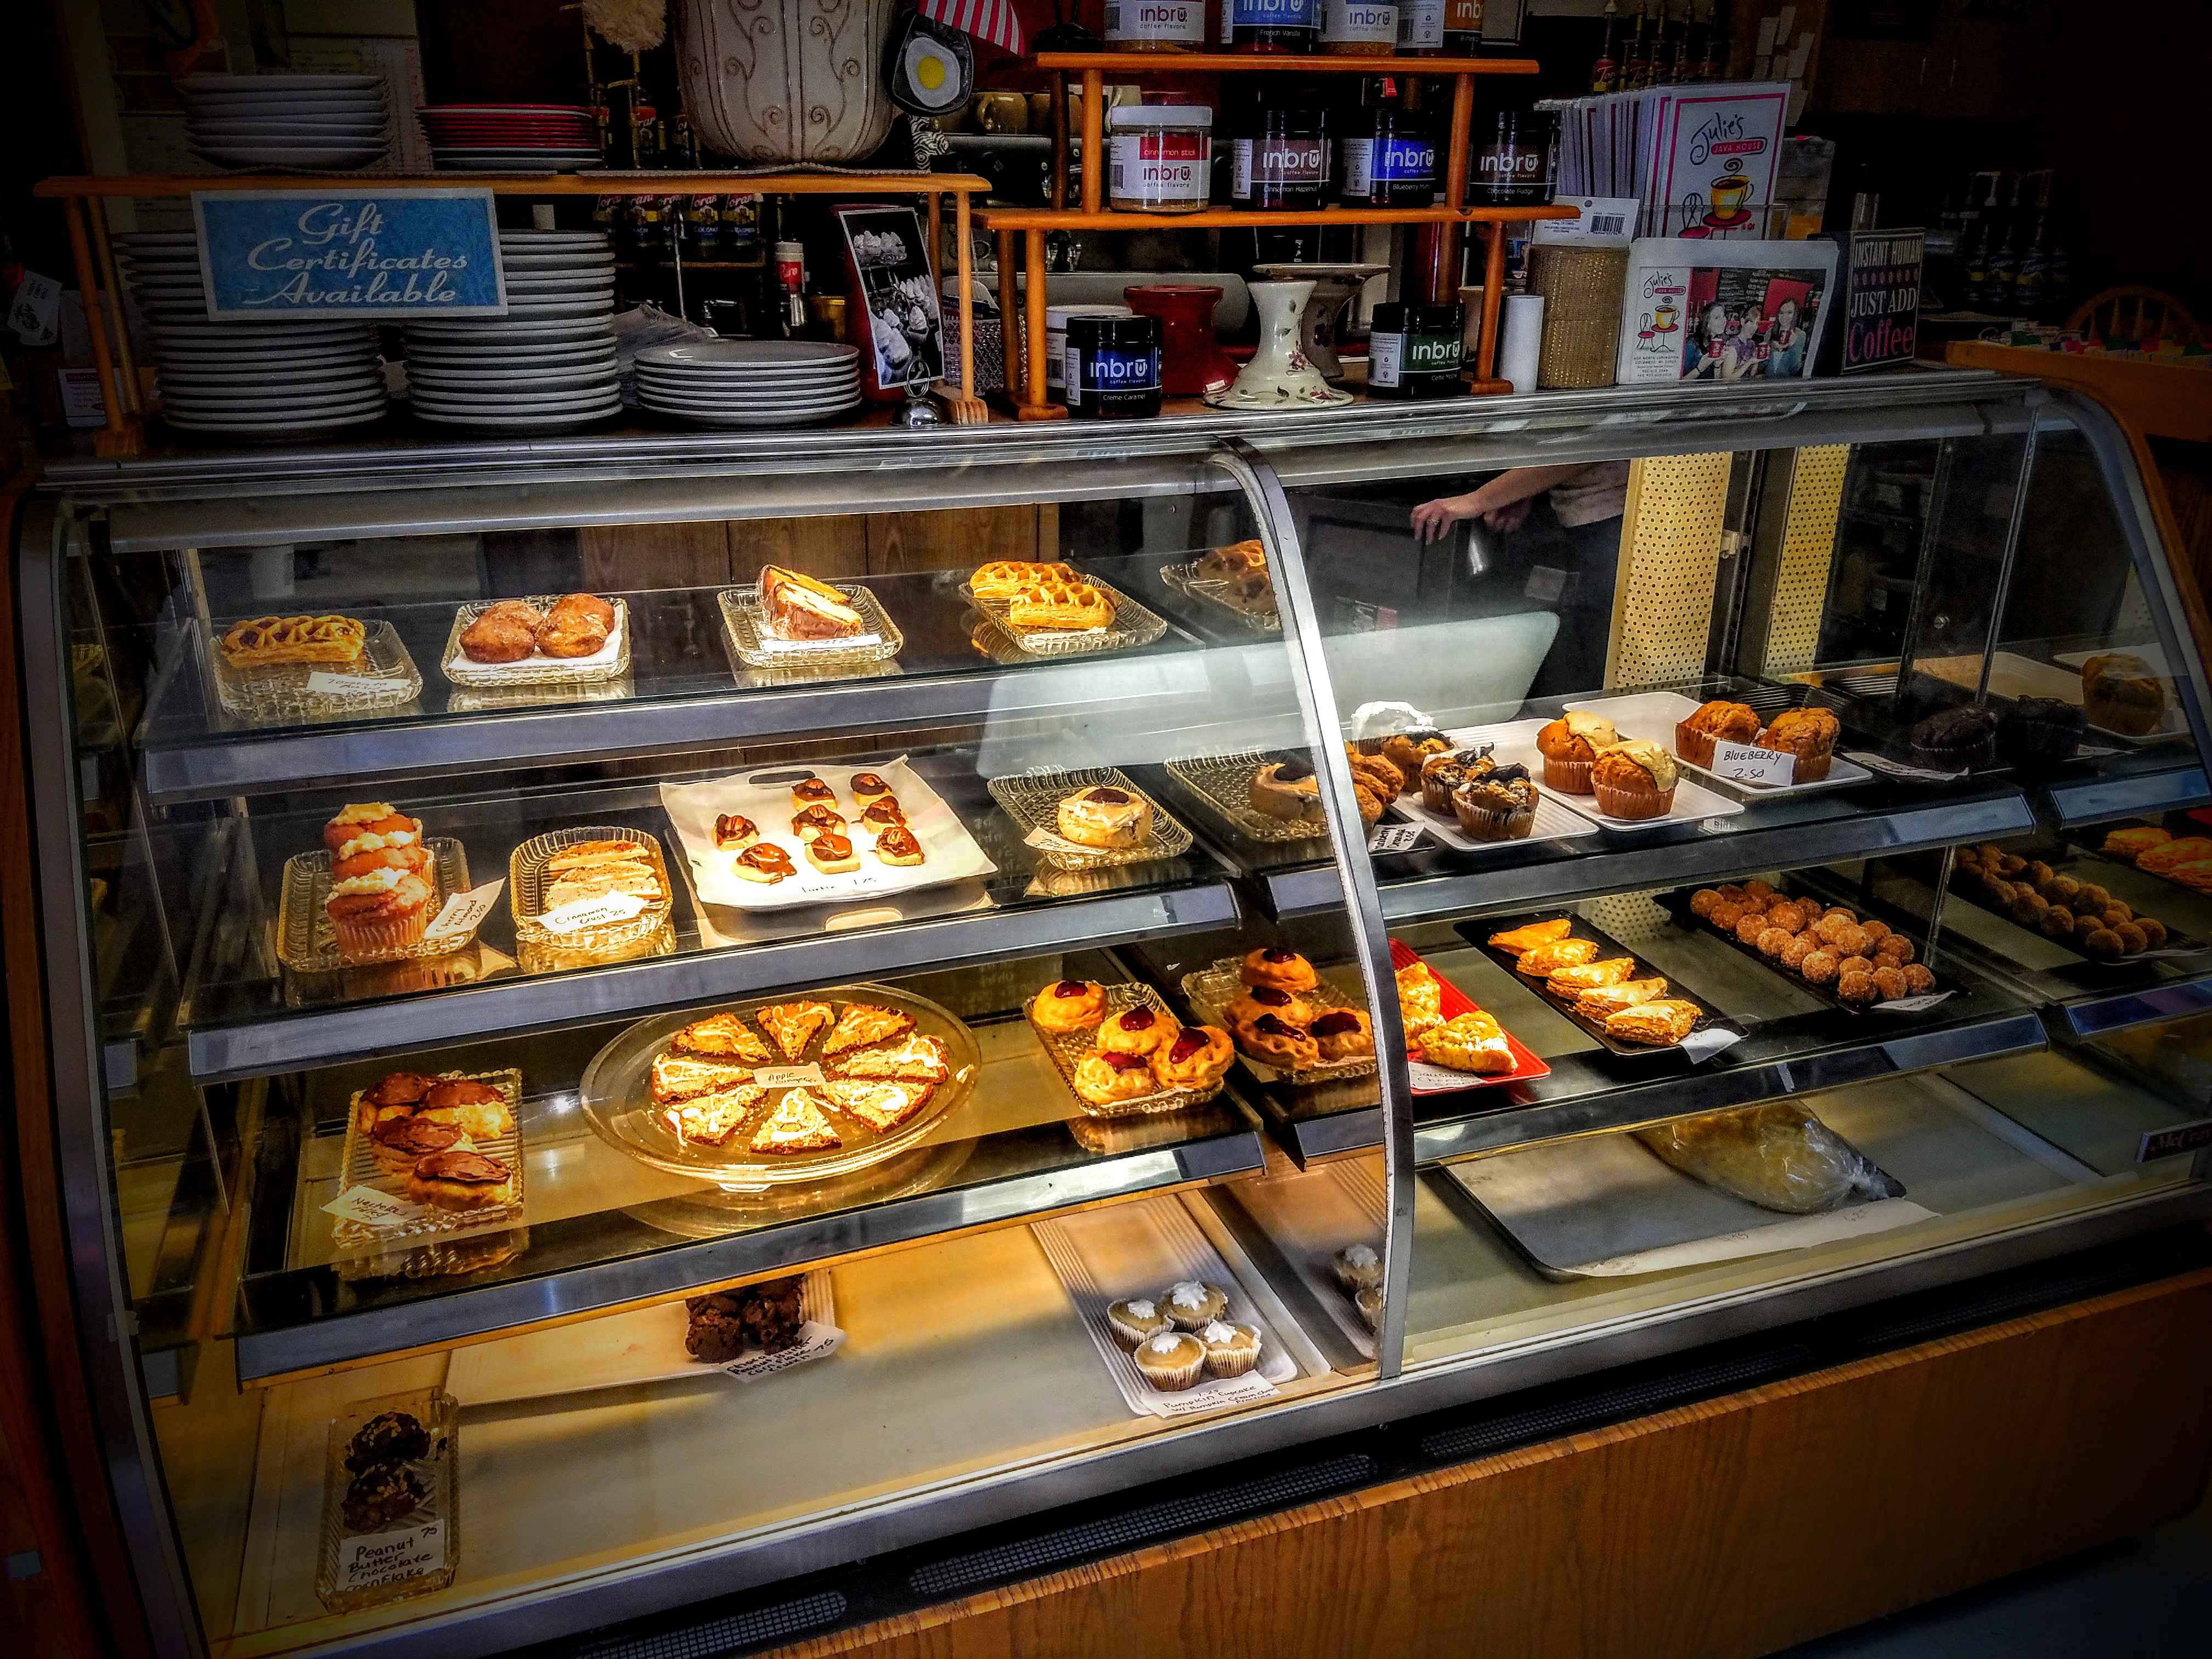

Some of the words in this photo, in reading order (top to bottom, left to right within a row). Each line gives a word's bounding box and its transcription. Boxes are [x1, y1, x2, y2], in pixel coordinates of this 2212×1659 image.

[1690, 112, 1745, 165] Julie's
[298, 203, 383, 244] Gift
[247, 238, 467, 278] Certificates
[1854, 241, 1889, 268] INSTANT
[1891, 239, 1922, 266] HUMAN
[242, 270, 456, 304] Available
[1644, 272, 1672, 298] Julie's
[1850, 291, 1886, 318] JUST
[1888, 288, 1916, 313] ADD
[1849, 318, 1913, 362] Coffee
[1733, 768, 1764, 779] 2.50
[436, 908, 465, 933] Cherry
[455, 900, 477, 927] Almond
[555, 907, 608, 925] Cinnamon
[768, 1072, 794, 1081] Apple
[1163, 1396, 1215, 1408] Pumpkin
[1218, 1386, 1256, 1396] Cupcake
[1189, 1400, 1226, 1410] Pumpkin
[1228, 1393, 1256, 1402] Cream
[1198, 1389, 1218, 1397] 1.25
[356, 1536, 415, 1561] Peanut
[347, 1551, 405, 1575] Butter
[348, 1553, 433, 1583] Chocolate
